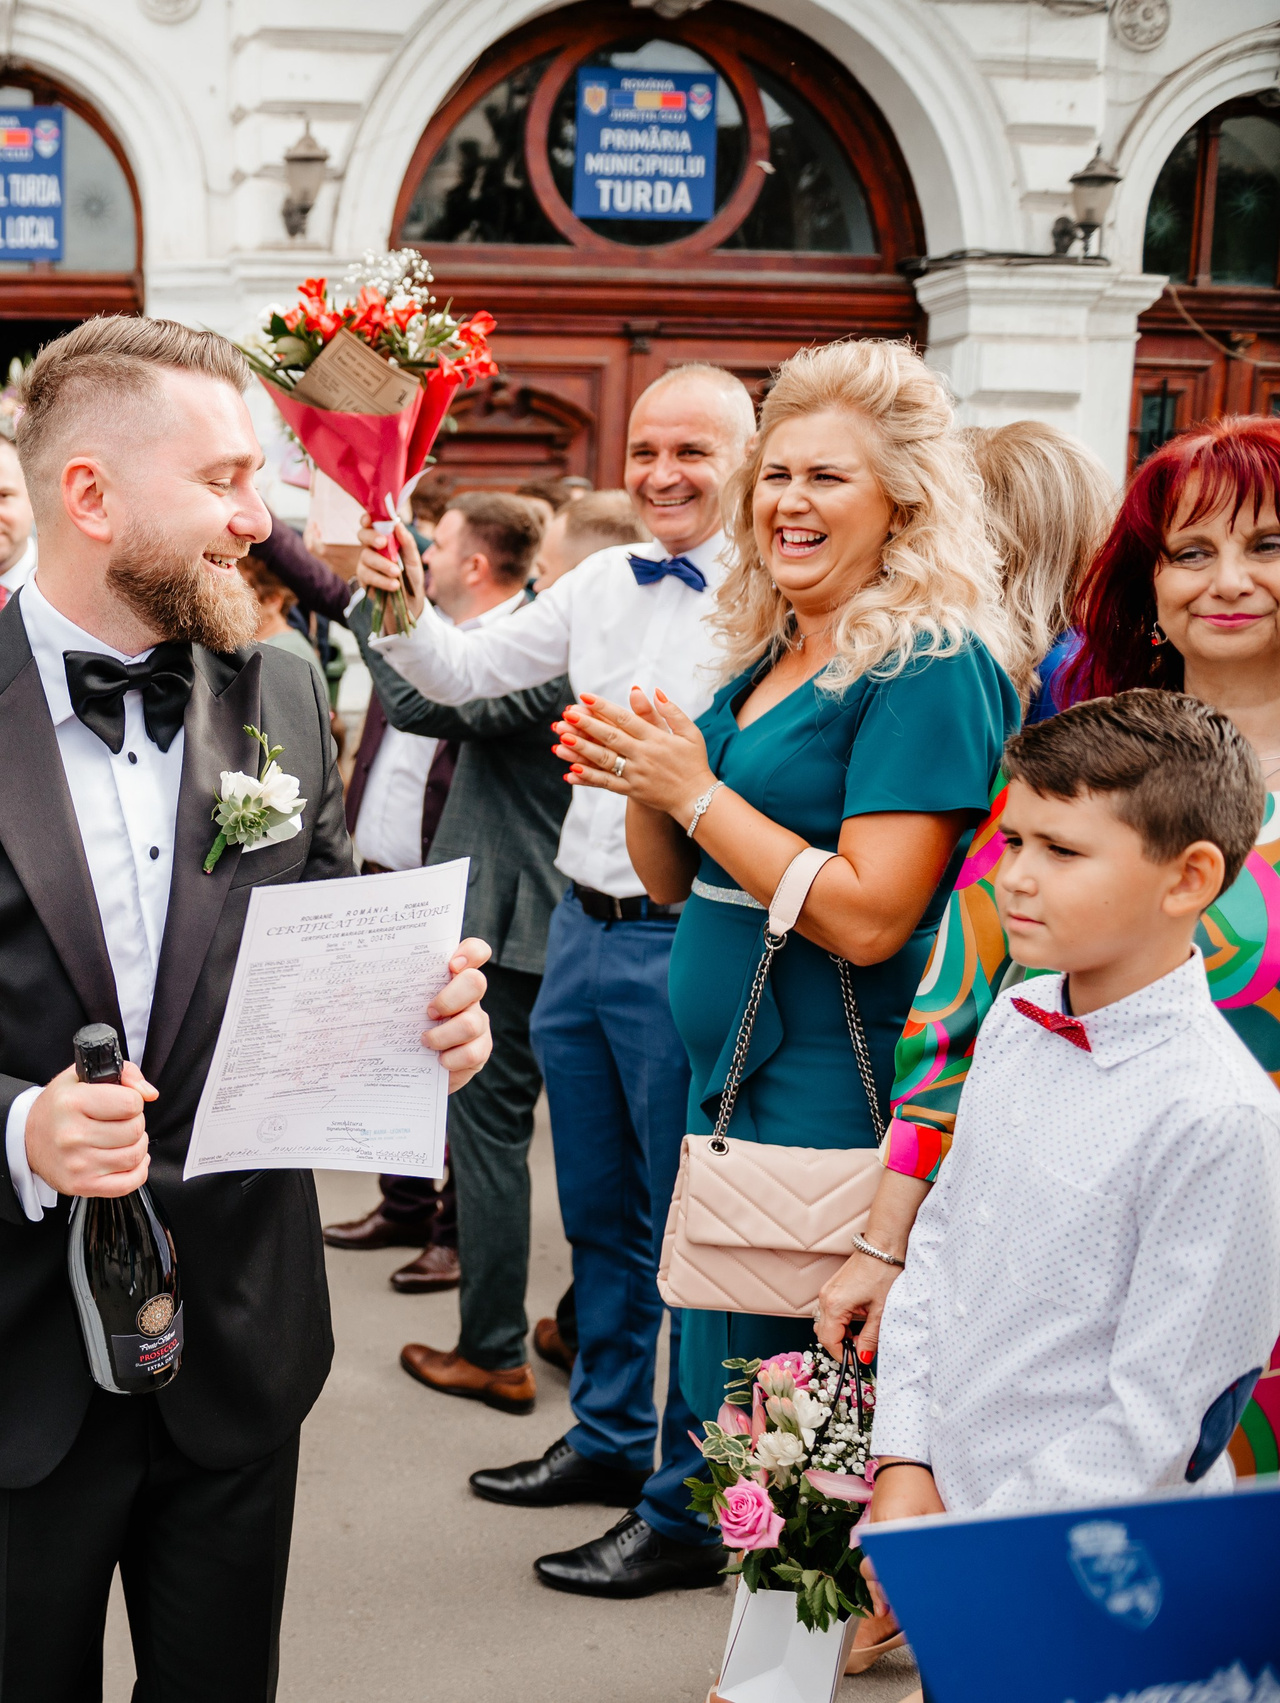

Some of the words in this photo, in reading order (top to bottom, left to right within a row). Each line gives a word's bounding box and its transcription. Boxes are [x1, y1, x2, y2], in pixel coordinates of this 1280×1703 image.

[621, 77, 675, 91] ROMÂNIA
[600, 125, 692, 153] PRIMĂRIA
[584, 152, 706, 178] MUNICIPIULUI
[8, 173, 61, 207] TURDA
[595, 179, 693, 214] TURDA
[6, 215, 58, 248] LOCAL
[266, 918, 357, 936] CERTIFICAT
[356, 915, 378, 927] DE
[379, 903, 451, 924] CĂSĂTORIE
[300, 913, 334, 921] ROUMANIE
[346, 906, 389, 917] ROMÂNIA
[404, 901, 429, 909] ROMANIA
[301, 933, 332, 942] CERTIFICAT
[368, 925, 395, 934] MARRIAGE
[395, 921, 427, 931] CERTIFICATE
[139, 1338, 178, 1362] PROSECCO
[147, 1362, 165, 1371] EXTRA
